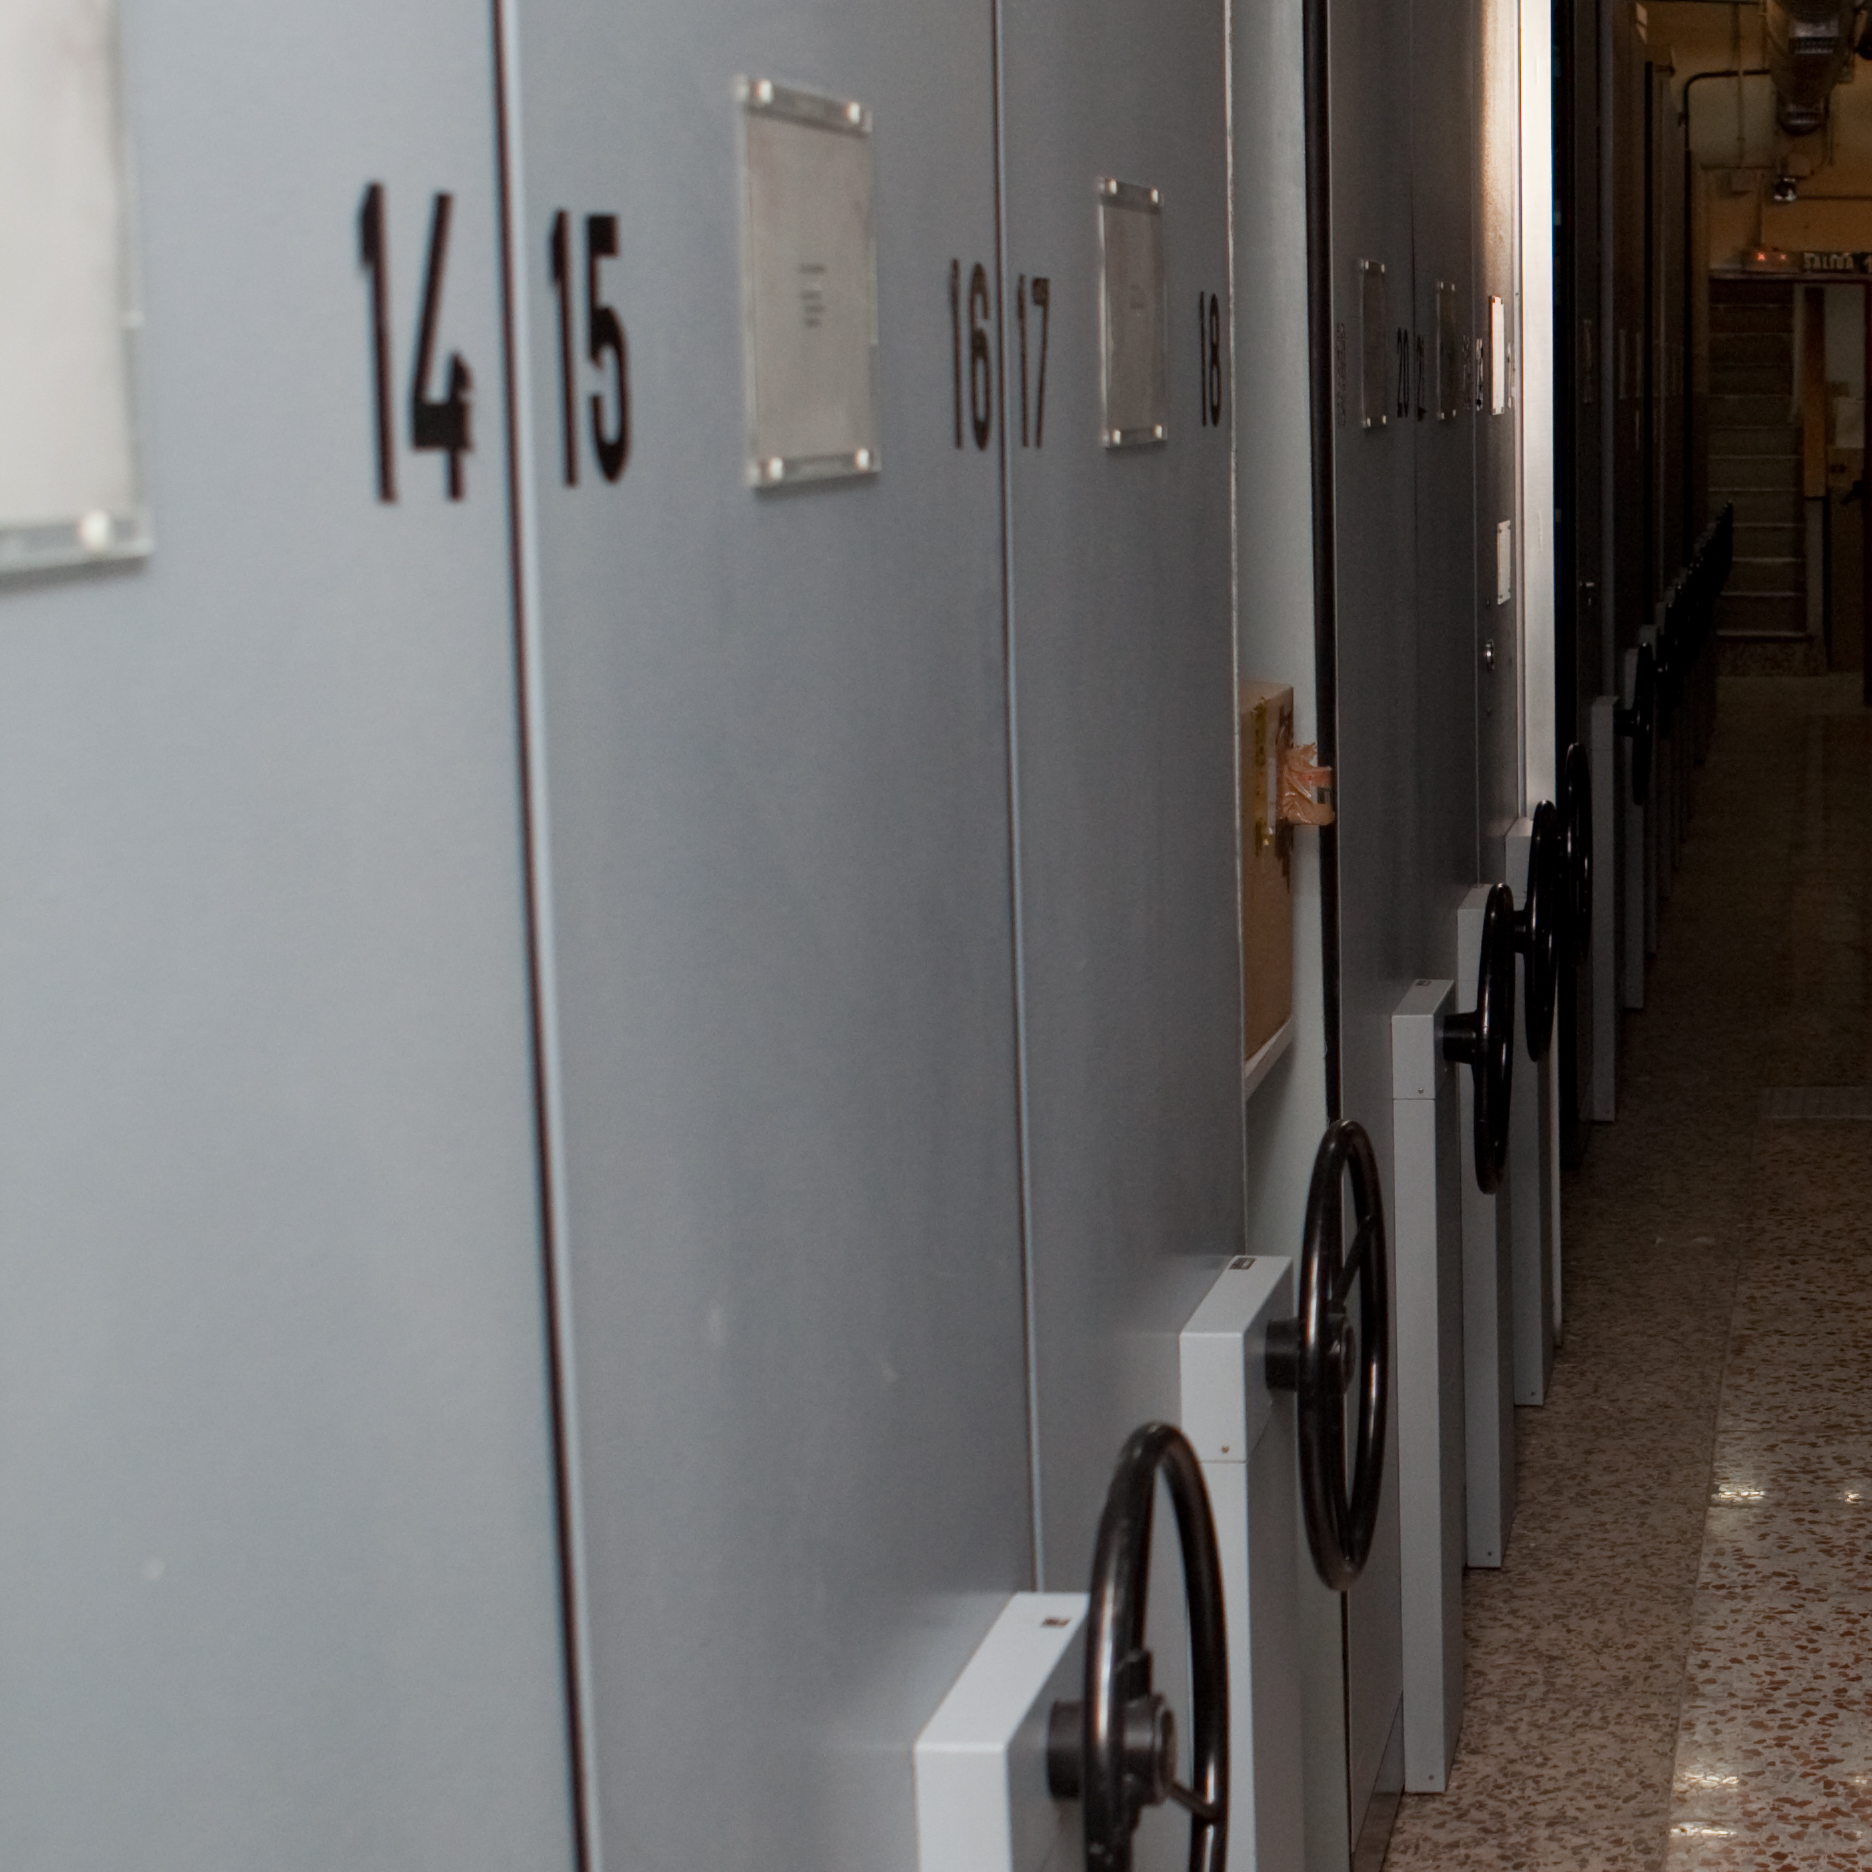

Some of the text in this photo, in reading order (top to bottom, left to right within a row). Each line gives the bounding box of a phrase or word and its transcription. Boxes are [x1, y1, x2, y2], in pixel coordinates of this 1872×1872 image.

[359, 181, 475, 503] 14
[550, 207, 630, 487] 15
[1804, 252, 1854, 270] SALIDA
[950, 258, 991, 452] 16
[1017, 273, 1049, 449] 17
[1200, 290, 1222, 428] 18
[1396, 327, 1410, 419] 20
